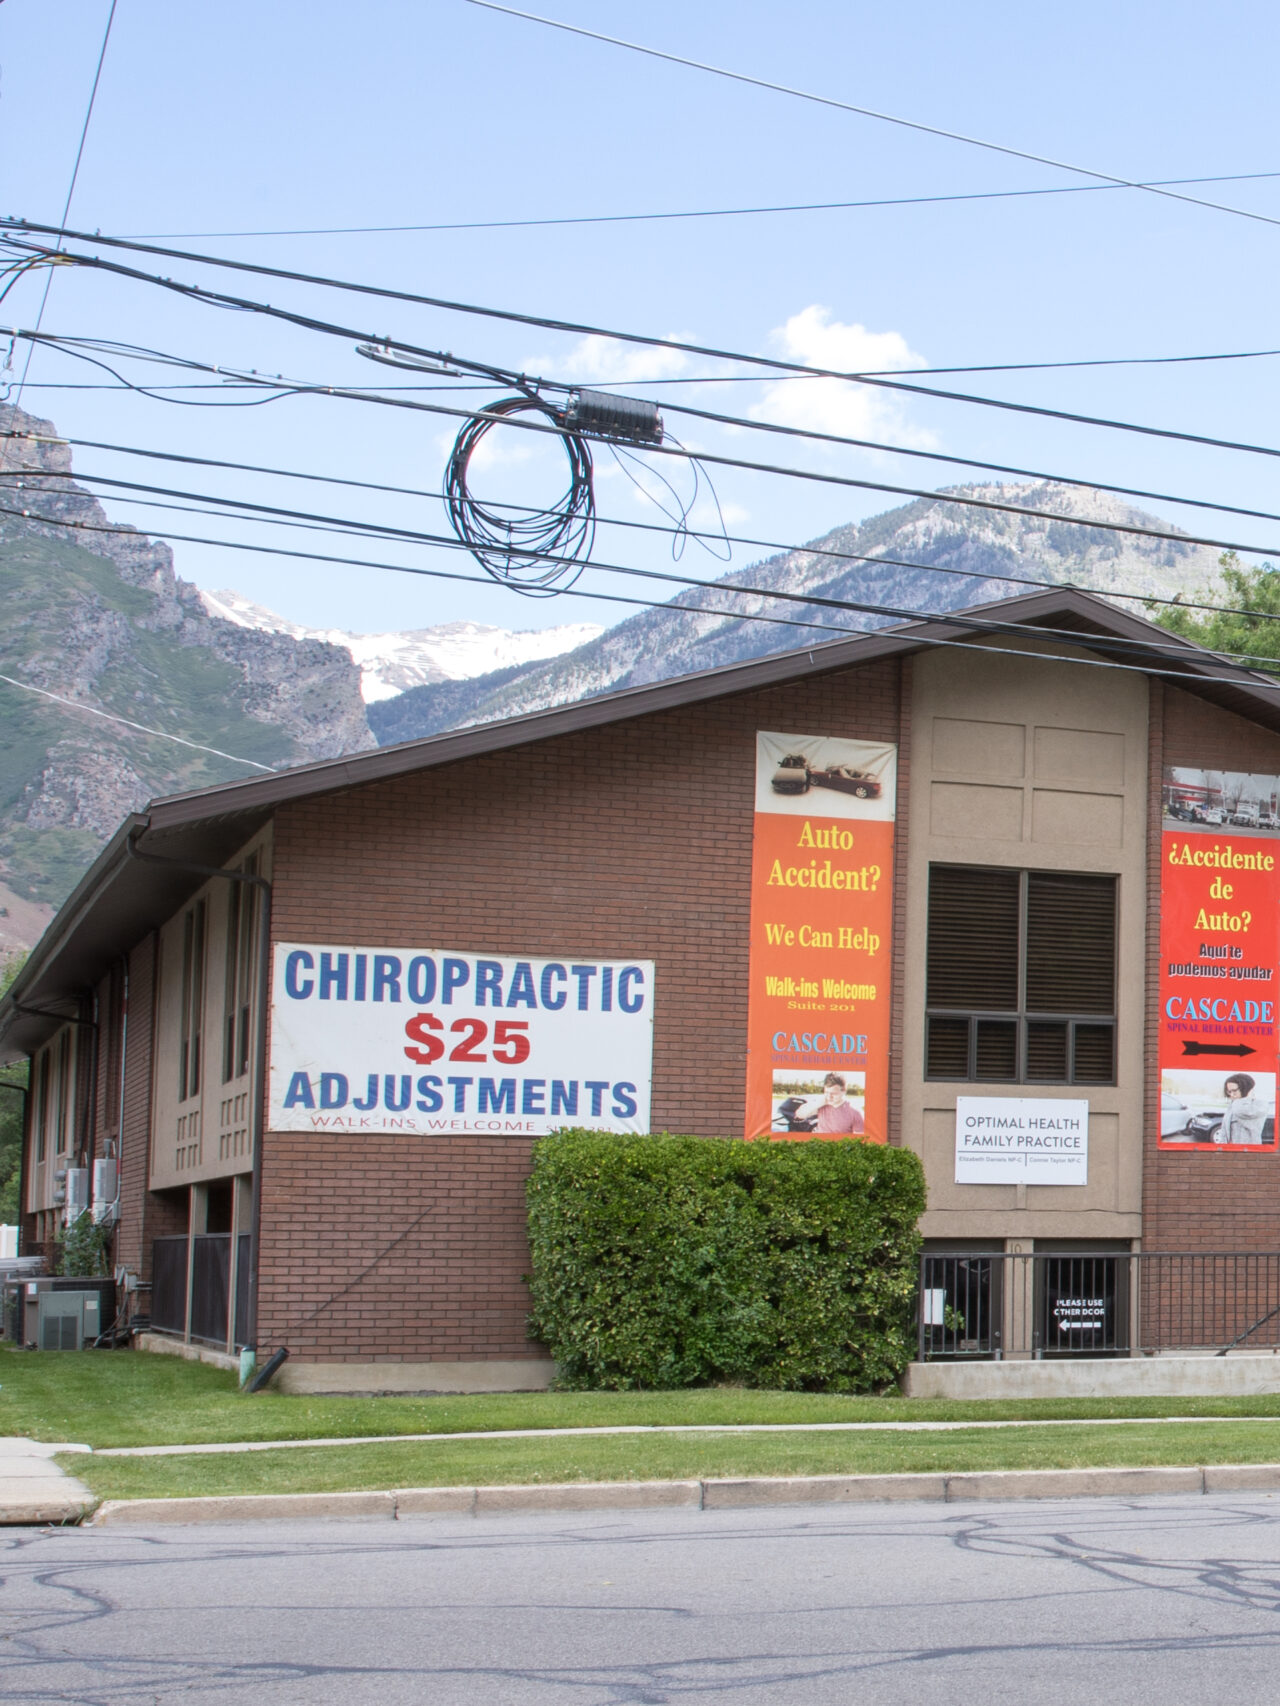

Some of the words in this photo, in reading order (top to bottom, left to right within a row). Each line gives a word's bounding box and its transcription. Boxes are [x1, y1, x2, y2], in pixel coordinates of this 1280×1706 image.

[797, 820, 854, 850] Auto
[1168, 843, 1274, 871] ¿Accidente
[766, 859, 881, 891] Accident?
[1209, 876, 1233, 900] de
[1194, 908, 1252, 932] Auto?
[764, 923, 795, 946] We
[798, 924, 833, 948] Can
[838, 926, 880, 956] Help
[1199, 943, 1229, 960] Aquí
[1229, 946, 1243, 960] te
[285, 950, 644, 1013] CHIROPRACTIC
[1168, 962, 1227, 978] podemos
[1229, 965, 1273, 980] ayudar
[765, 976, 819, 998] Walk-ins
[822, 978, 876, 1001] Welcome
[787, 1000, 826, 1010] Suite
[830, 1003, 855, 1012] 201
[1165, 996, 1274, 1024] CASCADE
[403, 1012, 531, 1065] $25
[1167, 1022, 1199, 1033] SPINAL
[1202, 1023, 1234, 1034] REHAB
[1236, 1025, 1273, 1036] CENTER
[771, 1031, 868, 1054] CASCADE
[282, 1071, 638, 1118] ADJUSTMENTS
[310, 1116, 416, 1128] WALK-INS
[428, 1119, 536, 1131] WELCOME
[965, 1116, 1025, 1129] OPTIMAL
[1028, 1117, 1080, 1130] HEALTH
[964, 1134, 1014, 1147] FAMILY
[1017, 1135, 1081, 1148] PRACTICE
[1053, 1308, 1081, 1316] OTHER
[1082, 1308, 1105, 1316] DOOR
[1056, 1299, 1086, 1307] PLEASE
[1087, 1299, 1103, 1307] USE
